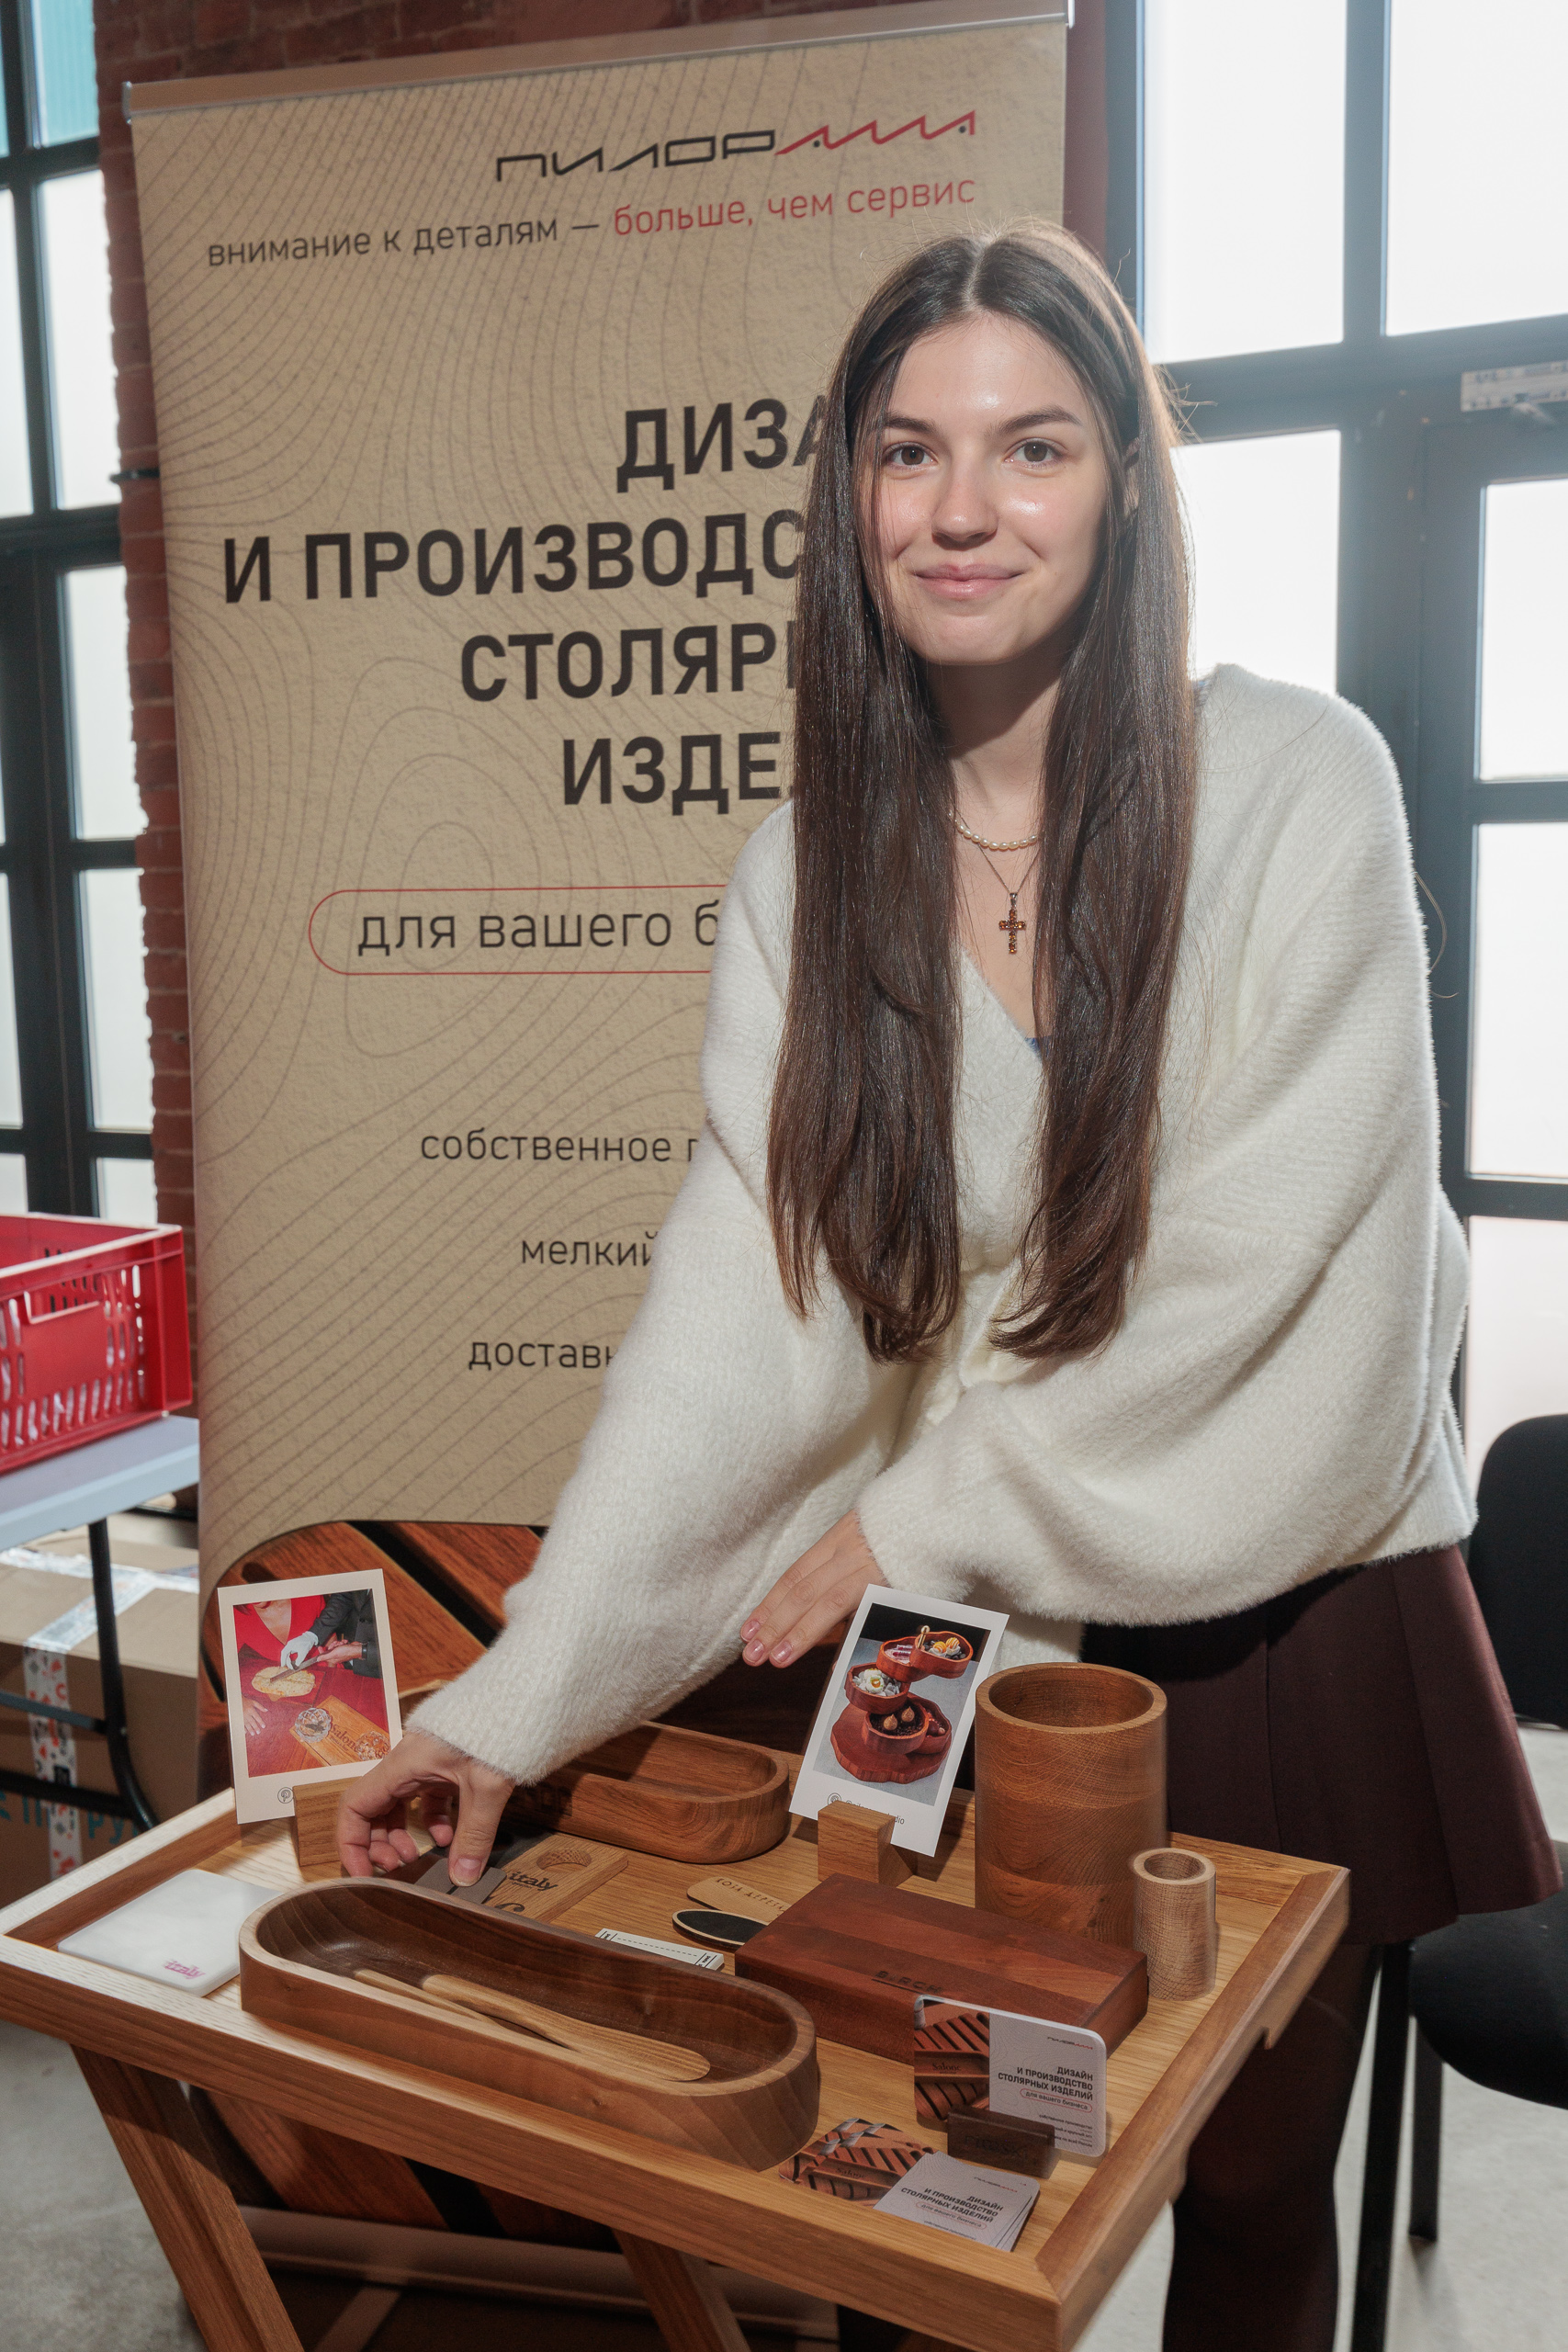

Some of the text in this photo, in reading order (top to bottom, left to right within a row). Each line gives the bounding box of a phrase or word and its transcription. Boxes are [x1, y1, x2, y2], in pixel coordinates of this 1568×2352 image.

[208, 232, 370, 266] внимание
[384, 230, 401, 254] к
[413, 219, 558, 255] деталям
[614, 200, 753, 236] больше,
[768, 191, 833, 220] чем
[846, 179, 976, 218] сервис
[223, 508, 806, 605] И ПРОИЗВОДС
[562, 731, 794, 816] ИЗДЕ
[358, 915, 456, 956] для
[479, 912, 671, 948] вашего
[421, 1127, 671, 1162] собственное
[522, 1231, 658, 1267] мелкий
[507, 1871, 558, 1892] italy
[998, 2072, 1093, 2101] СТОЛЯРНЫХ ИЗДЕЛИЙ
[1017, 2066, 1093, 2091] И ПРОИЗВОДСТВО
[1057, 2066, 1093, 2082] ДИЗАЙН
[1039, 2094, 1061, 2104] вашего
[1062, 2099, 1089, 2110] бизнеса
[900, 2187, 994, 2223] СТОЛЯРНЫХ ИЗДЕЛИЙ
[931, 2189, 998, 2217] ПРОИЗВОДСТВО
[967, 2195, 1004, 2211] ДИЗАЙН
